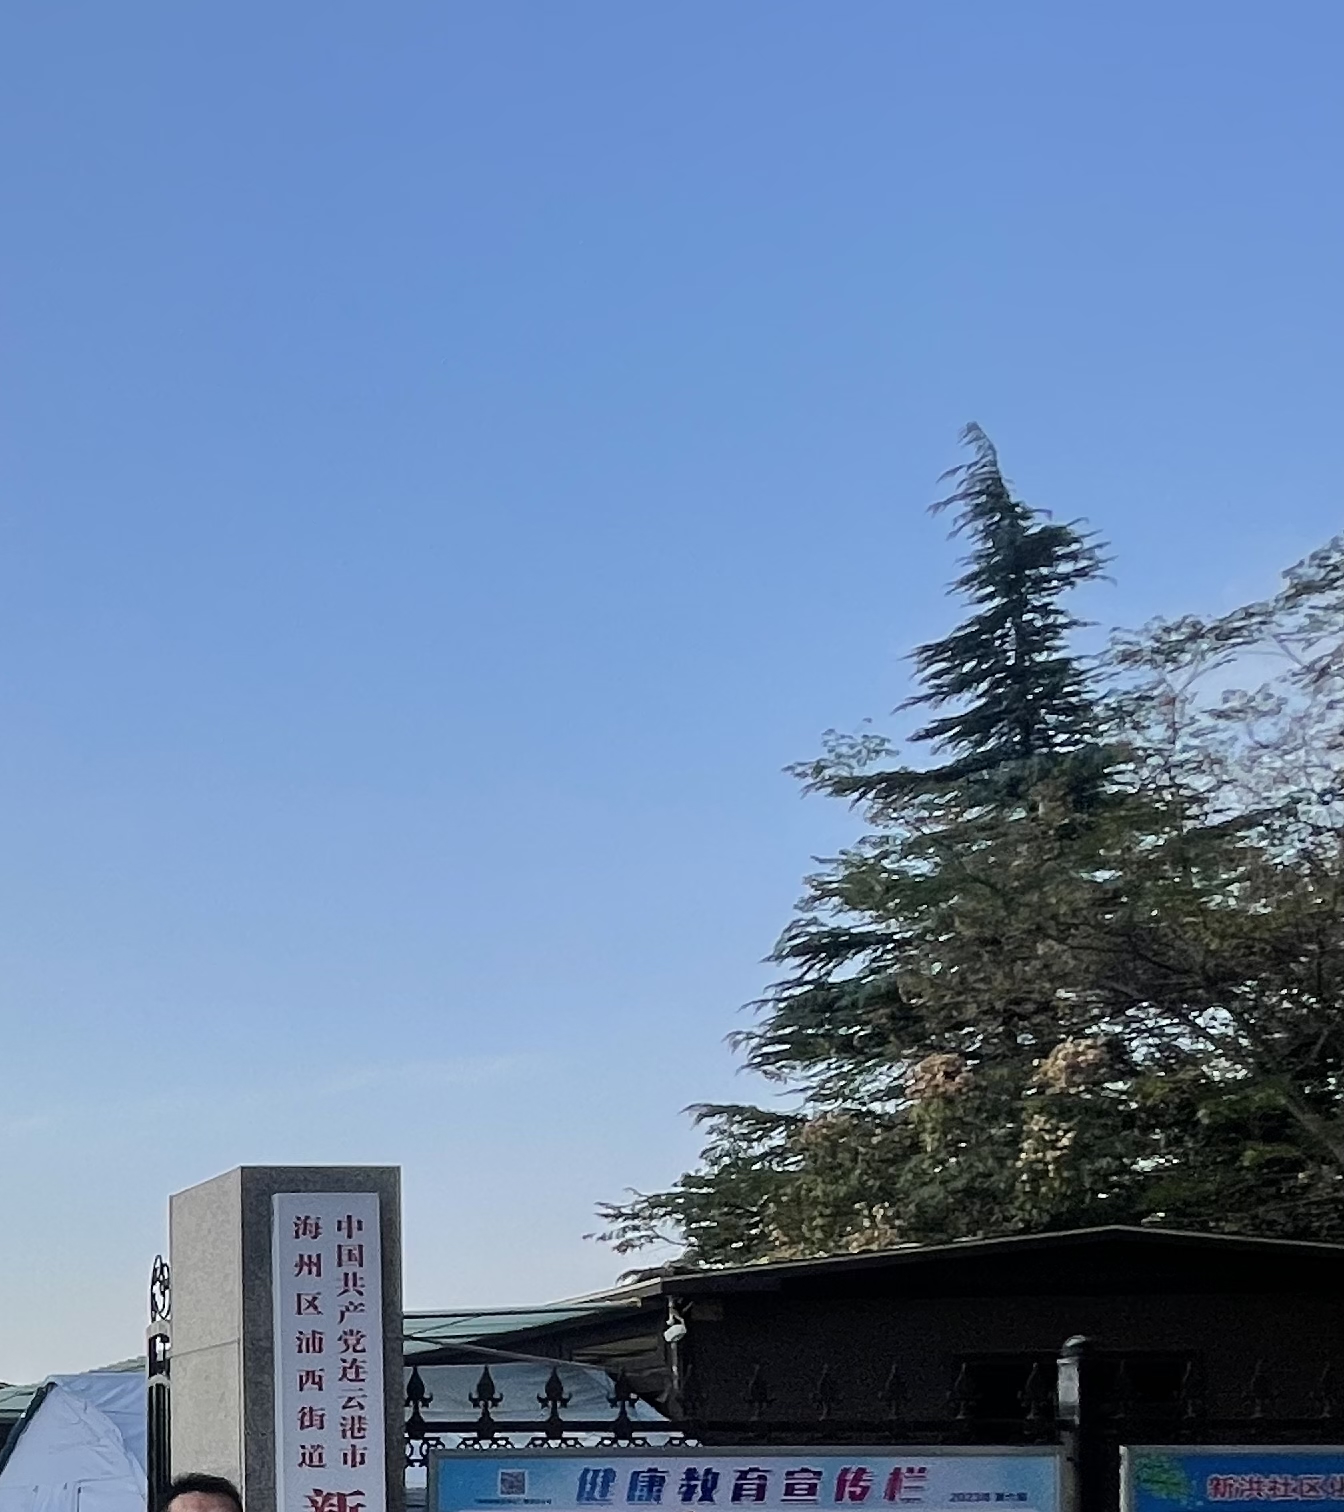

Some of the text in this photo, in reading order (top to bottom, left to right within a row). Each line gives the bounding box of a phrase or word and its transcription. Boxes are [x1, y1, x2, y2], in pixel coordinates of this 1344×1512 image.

[293, 1214, 327, 1469] 海州区浦西街道
[335, 1214, 369, 1469] 中国共产党连云港市
[576, 1466, 929, 1503] 健康教育宣传栏
